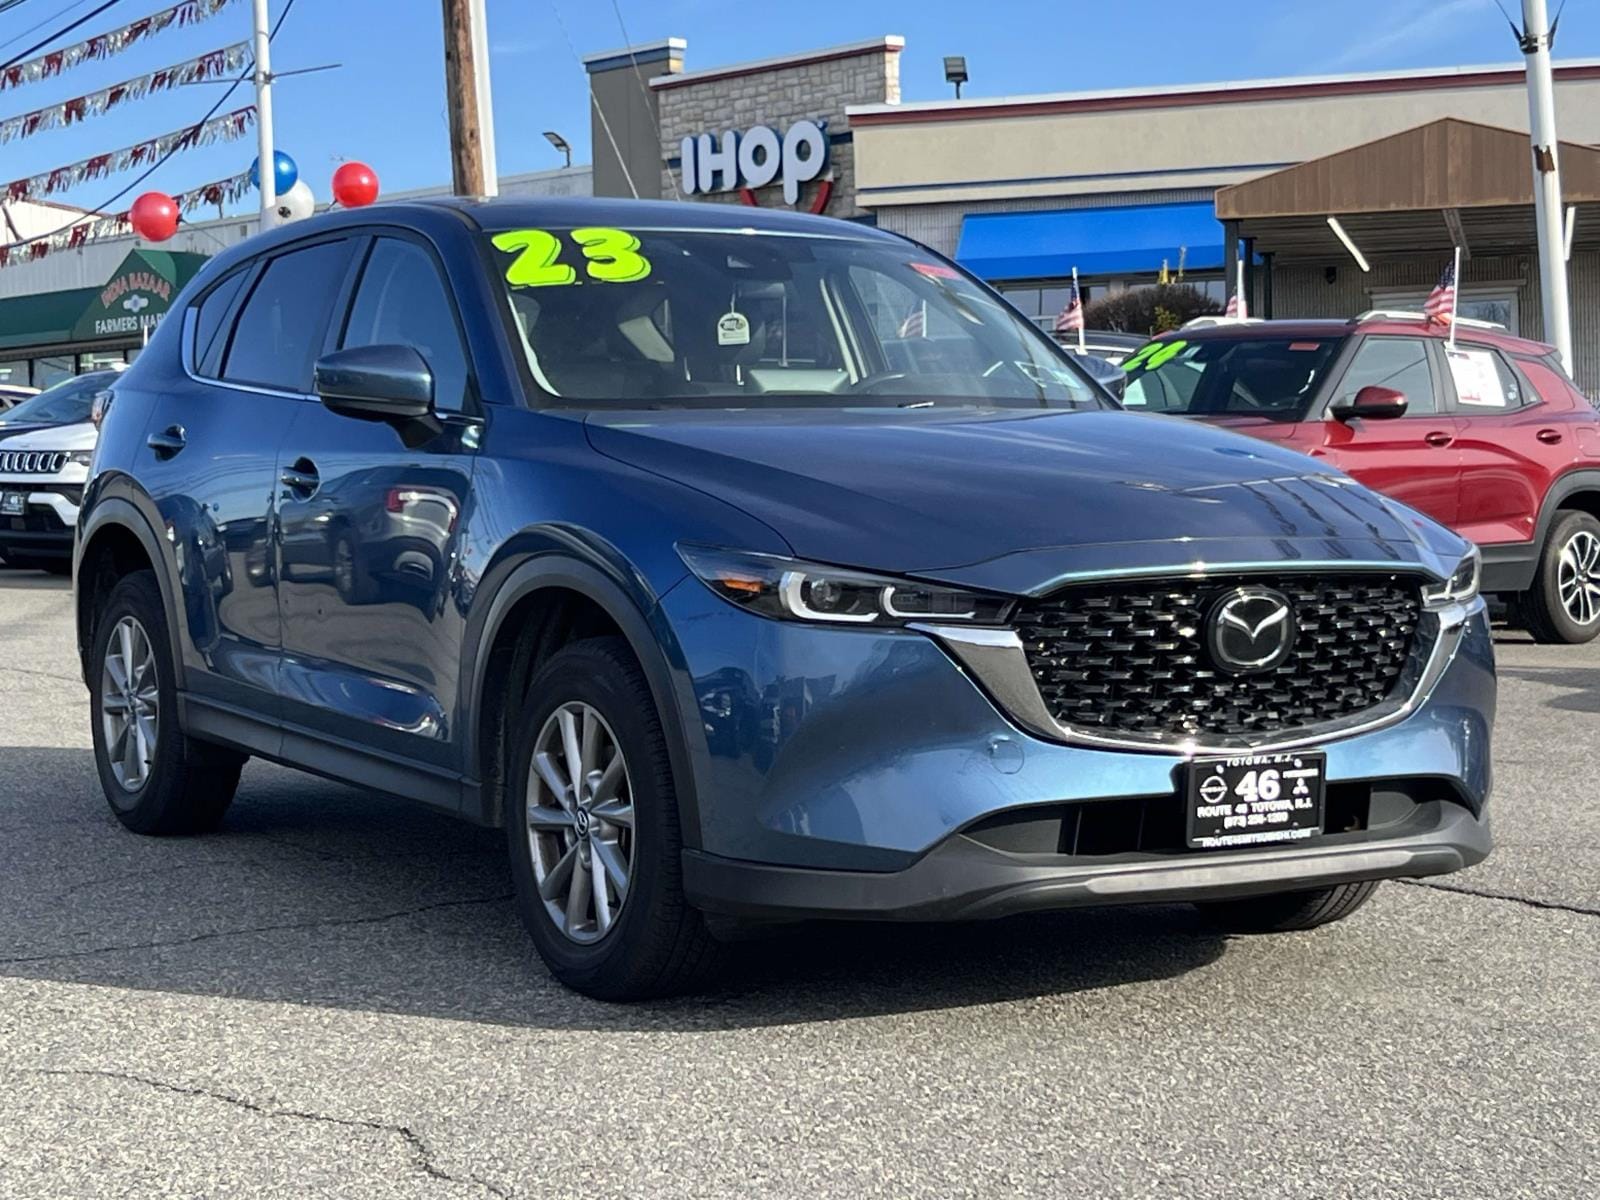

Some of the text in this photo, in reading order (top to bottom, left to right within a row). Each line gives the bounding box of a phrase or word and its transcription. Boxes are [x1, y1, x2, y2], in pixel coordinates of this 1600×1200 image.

[681, 120, 827, 206] IHOP
[491, 227, 652, 287] 23
[101, 272, 171, 309] INDIA BAZAAR
[95, 316, 138, 334] FARMERS
[1235, 769, 1281, 802] 46
[1197, 804, 1232, 818] ROUTE
